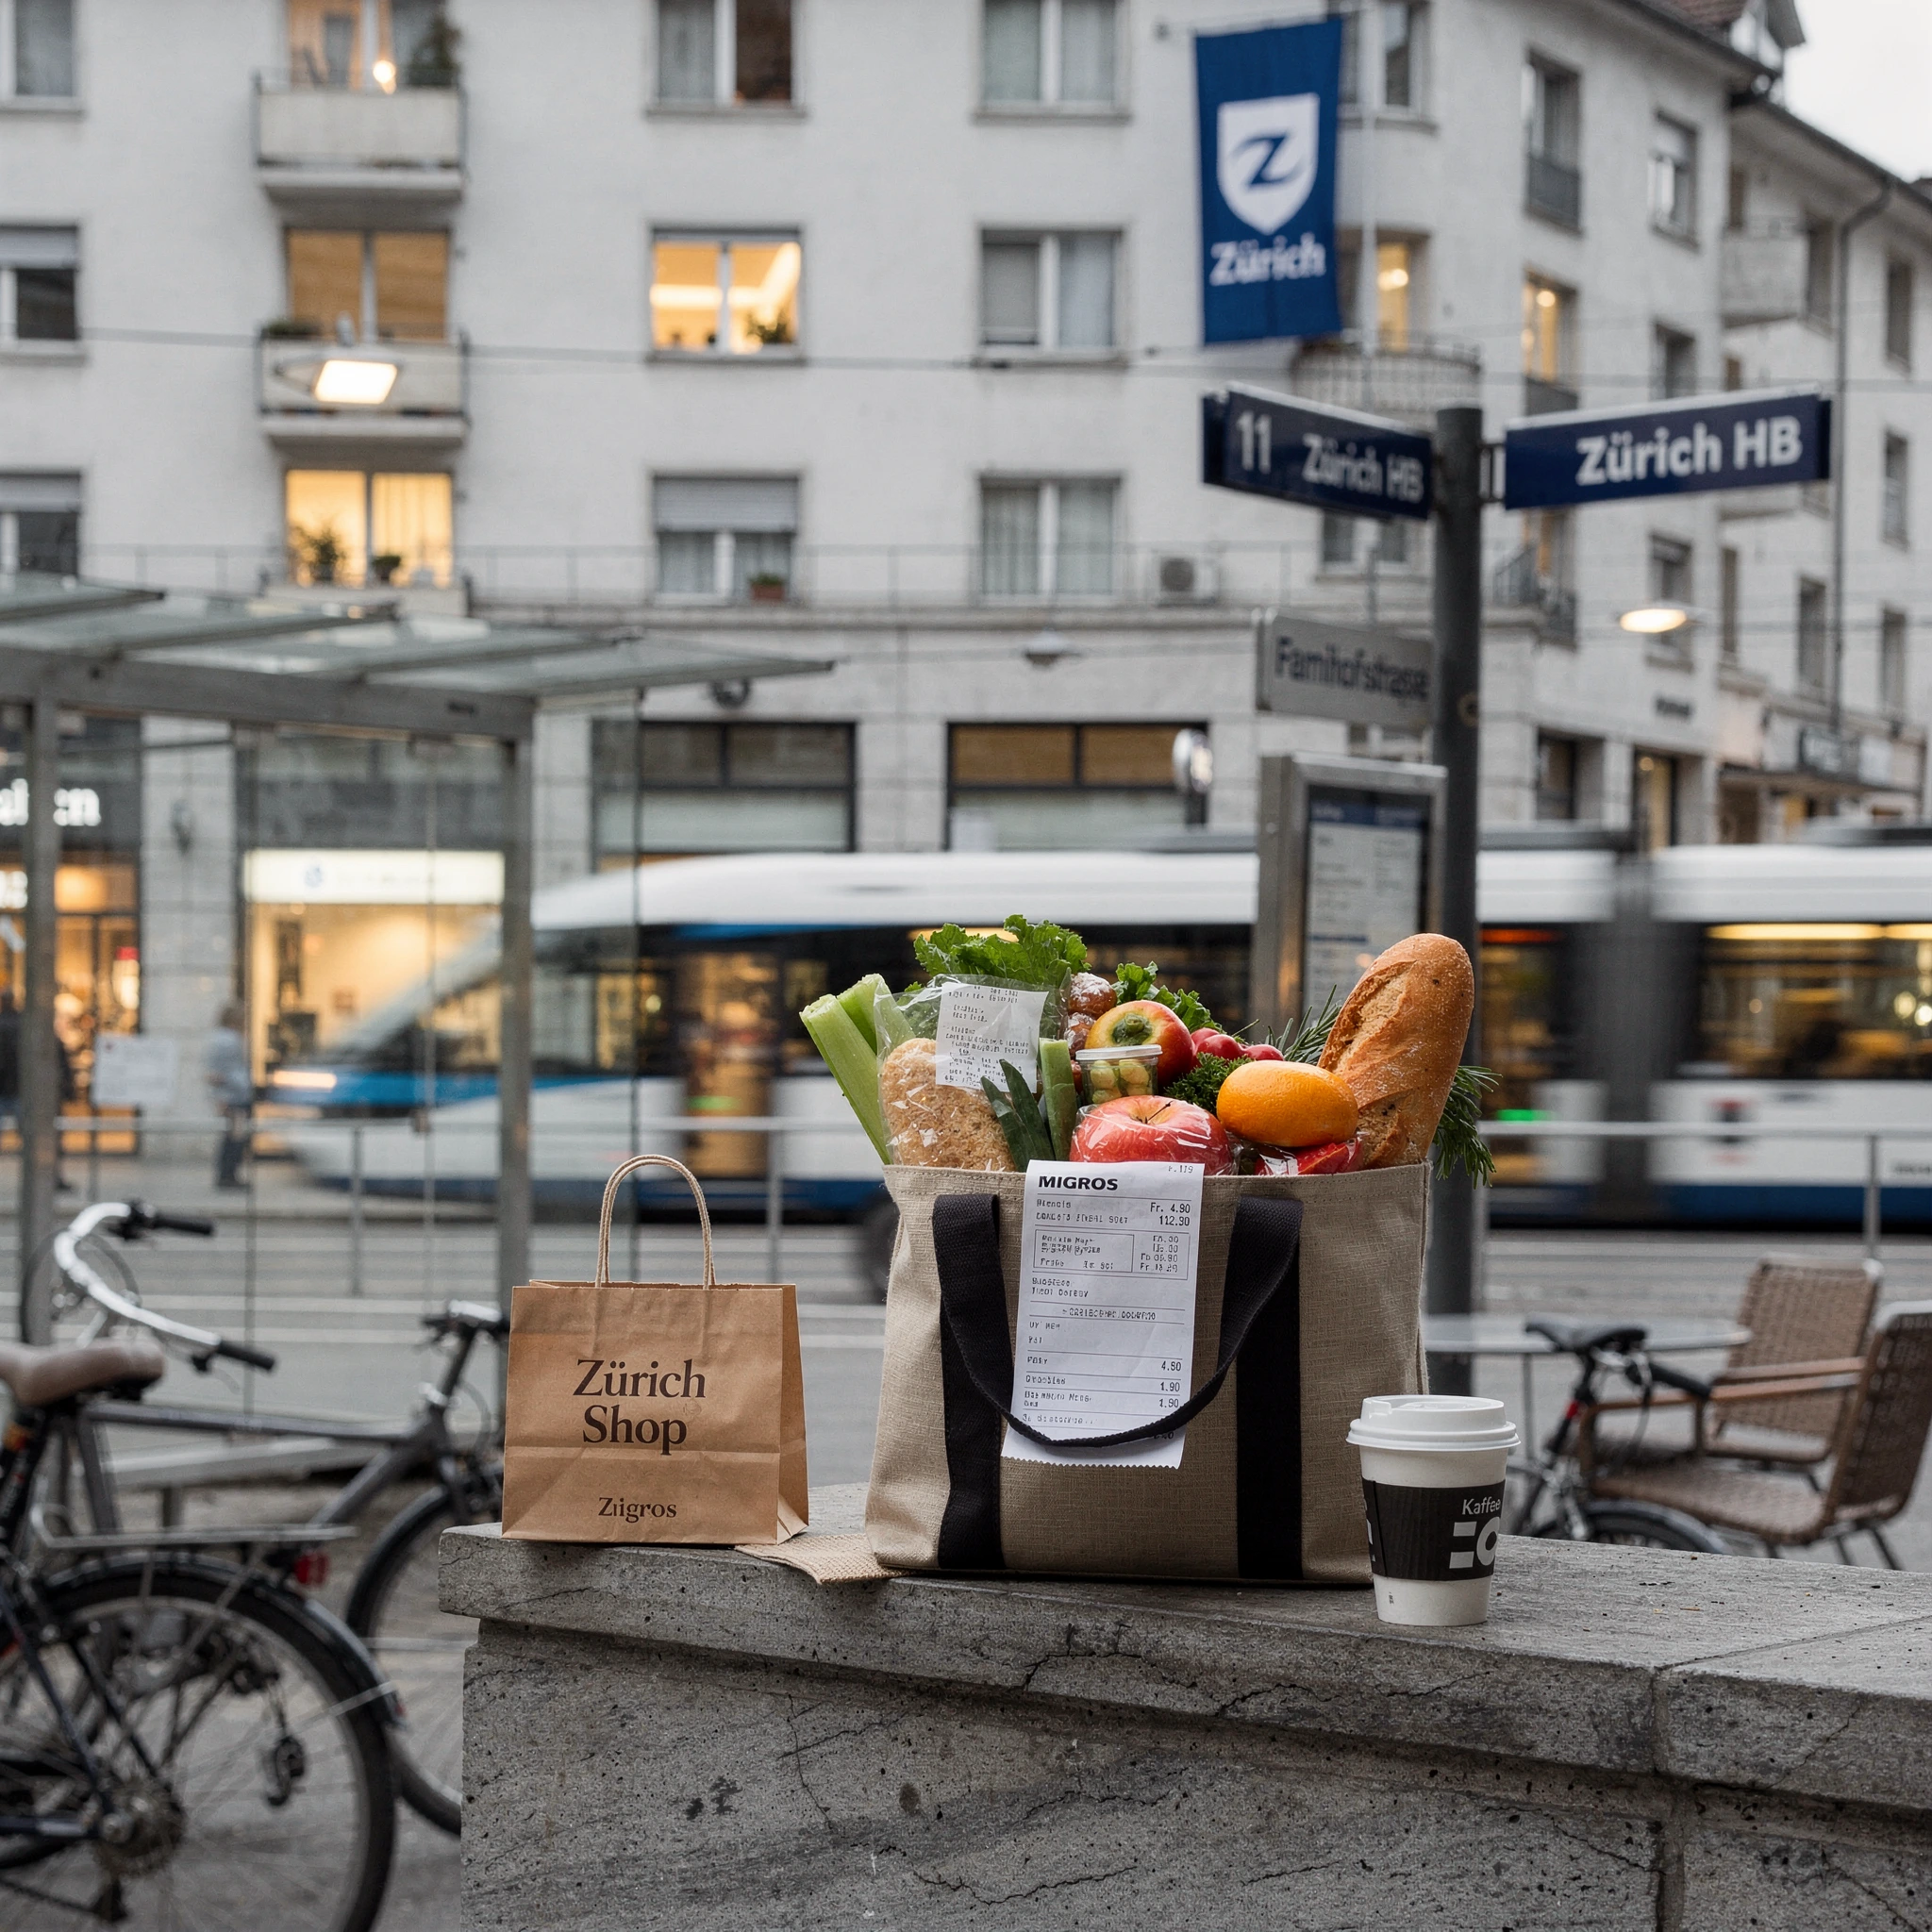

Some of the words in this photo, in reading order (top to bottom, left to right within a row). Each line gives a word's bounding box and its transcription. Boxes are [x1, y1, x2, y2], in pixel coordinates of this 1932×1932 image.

[1210, 233, 1326, 287] Zürich
[1237, 409, 1271, 474] 11
[1302, 432, 1383, 495] Zürich
[1386, 453, 1424, 504] HB
[1575, 424, 1722, 486] Zürich
[1733, 416, 1803, 470] HB
[1038, 1175, 1119, 1191] MIGROS
[1150, 1202, 1164, 1213] Fr.
[573, 1358, 706, 1398] Zürich
[582, 1404, 688, 1456] Shop
[1461, 1496, 1502, 1515] Kaffee
